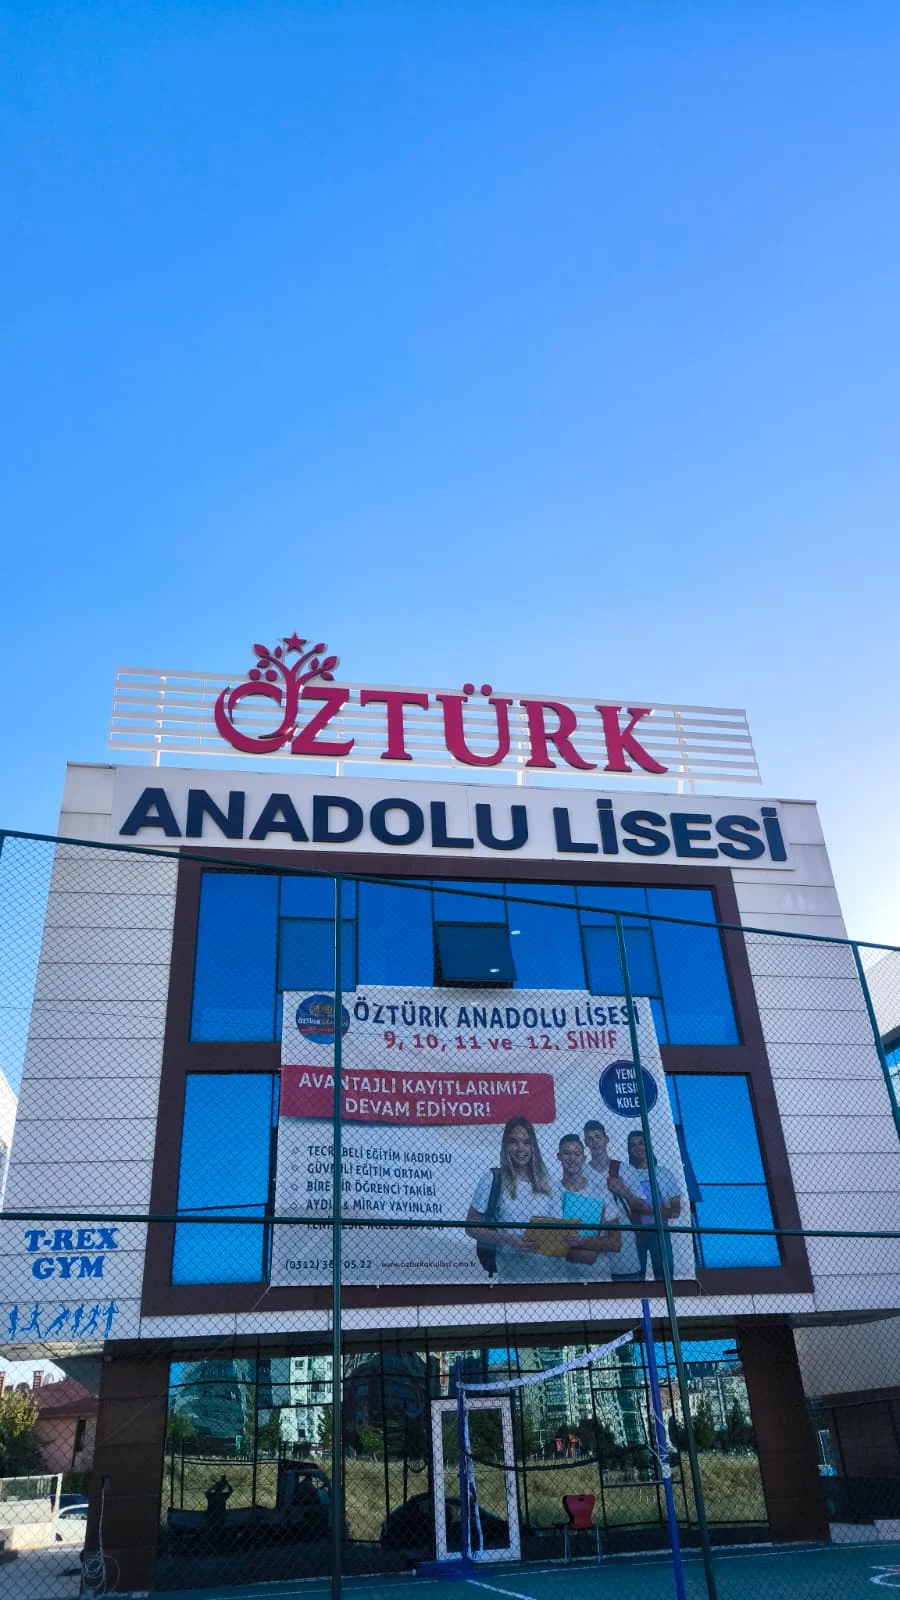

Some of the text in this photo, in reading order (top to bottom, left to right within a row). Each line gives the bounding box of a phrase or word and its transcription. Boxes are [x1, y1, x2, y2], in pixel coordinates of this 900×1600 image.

[214, 668, 669, 774] ÖZTÜRK
[119, 787, 787, 862] ANADOLU LİSESİ
[353, 996, 640, 1029] ÖZTÜRK ANADOLU LİSESİ
[383, 1030, 617, 1052] 9, 10, 11 ve 12. SINIF
[298, 1072, 529, 1095] AVANTAJLI KAYITLARIMIZ
[345, 1098, 491, 1117] DEVAM EDİYOR!
[616, 1096, 641, 1109] KOLE
[308, 1145, 452, 1164] TECRBELİ EĞİTİM KADROSU
[394, 1168, 433, 1180] ORTAMI
[307, 1179, 331, 1192] BİRE
[355, 1180, 400, 1195] ÖĞRENCİ
[402, 1184, 436, 1197] TAKİBİ
[306, 1199, 333, 1211] AYDI
[353, 1197, 385, 1211] MİRAY
[389, 1201, 443, 1214] YAYINLARI
[24, 1227, 119, 1252] T-REX
[32, 1255, 105, 1280] GYM
[285, 1260, 319, 1271] (0312)
[344, 1260, 356, 1269] 05
[360, 1260, 372, 1269] 22
